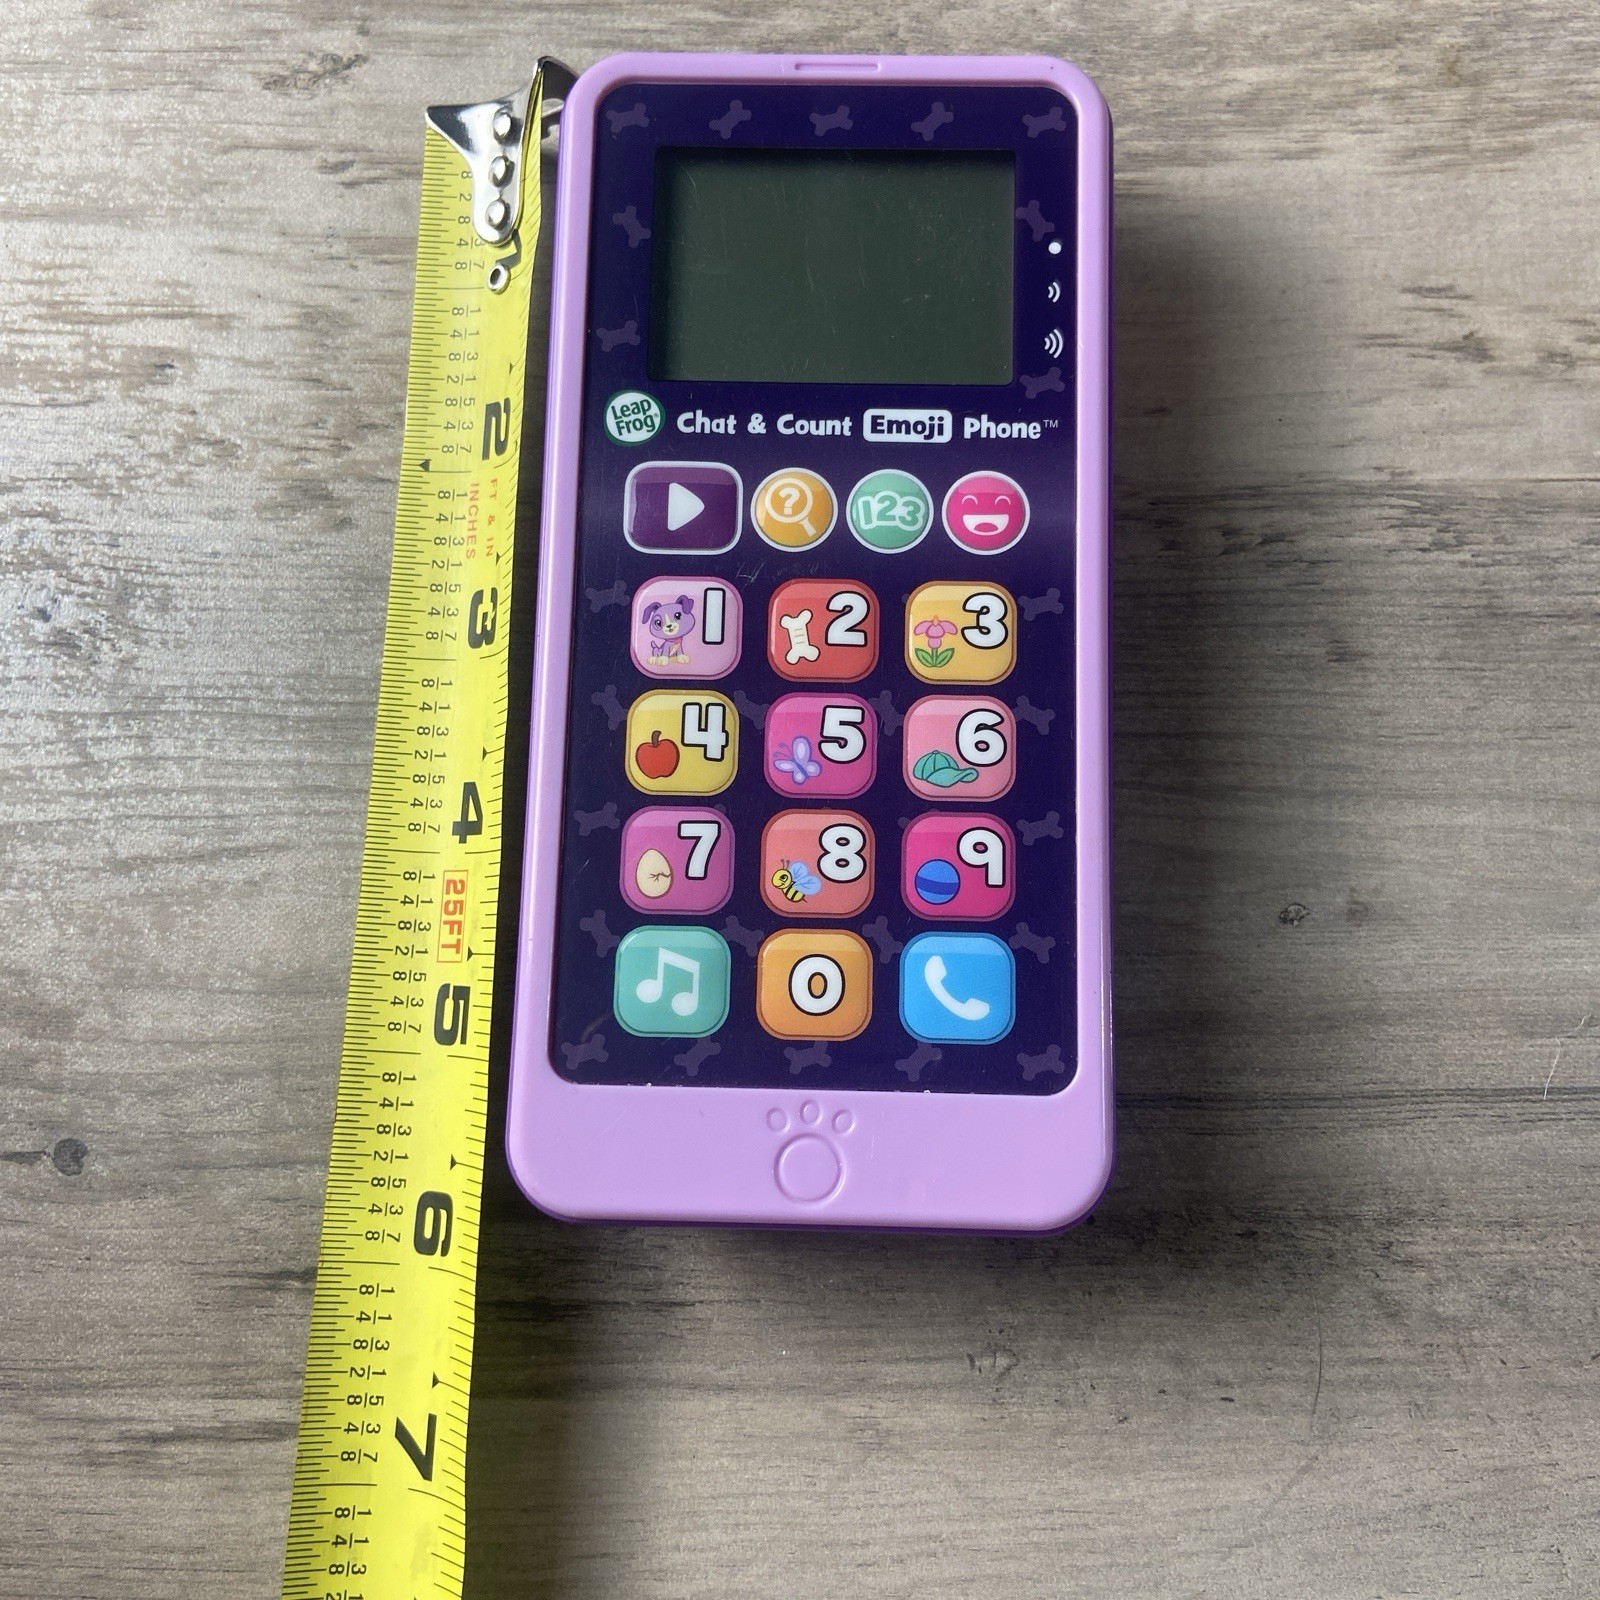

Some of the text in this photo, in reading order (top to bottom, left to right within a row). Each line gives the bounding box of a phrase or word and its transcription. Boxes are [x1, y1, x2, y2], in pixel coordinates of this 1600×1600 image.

[482, 398, 511, 461] 2
[611, 398, 651, 420] Leap
[677, 410, 737, 434] Chat
[748, 413, 766, 434] &
[777, 414, 852, 436] Count
[870, 415, 945, 440] Emoji
[466, 483, 479, 559] INCHES
[486, 478, 497, 557] FT & IN
[860, 492, 922, 529] 123
[468, 587, 498, 649] 3
[703, 588, 725, 645] 1
[825, 591, 869, 647] 2
[961, 593, 1008, 649] 3
[682, 703, 728, 761] 4
[819, 705, 865, 763] 5
[956, 709, 1006, 767] 6
[452, 782, 483, 844] 4
[678, 821, 720, 880] 7
[817, 824, 866, 883] 8
[957, 828, 1005, 887] 9
[441, 879, 465, 954] 25FT
[434, 983, 471, 1046] 5
[788, 954, 845, 1016] 0
[414, 1191, 453, 1257] 6
[395, 1413, 437, 1482] 7
